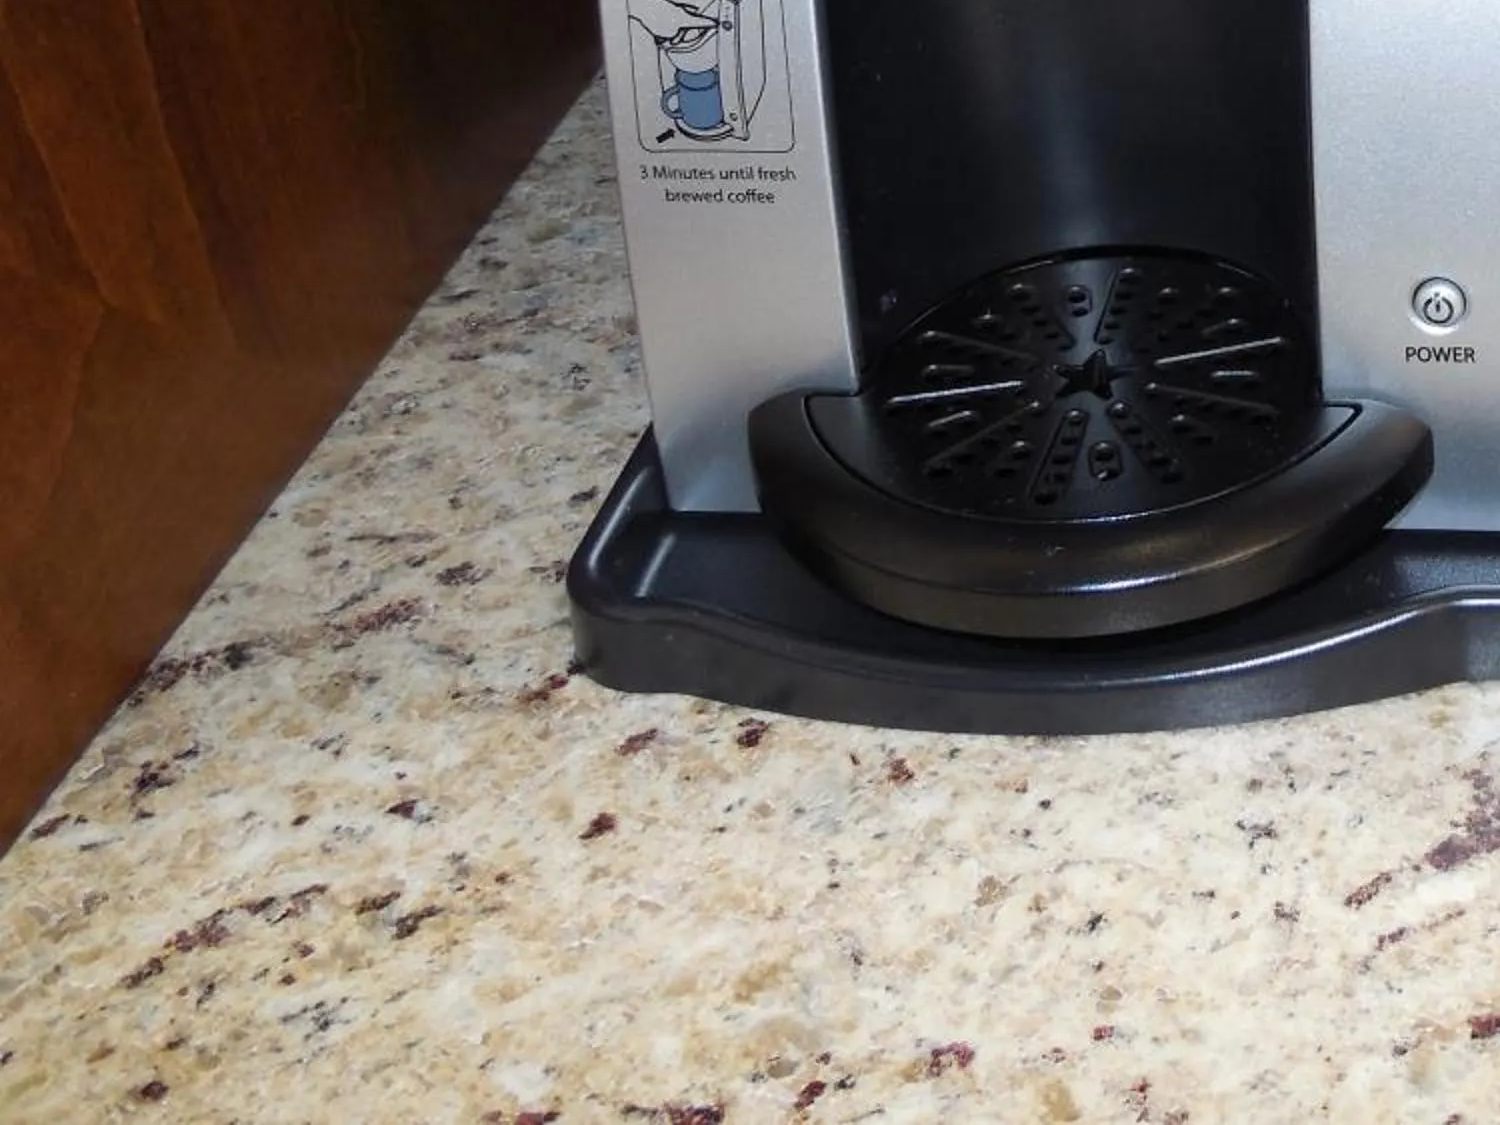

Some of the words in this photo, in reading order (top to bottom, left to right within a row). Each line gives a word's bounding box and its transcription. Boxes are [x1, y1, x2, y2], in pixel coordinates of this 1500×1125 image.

[639, 164, 649, 179] 3
[652, 165, 715, 180] Minutes
[719, 166, 754, 180] until
[757, 166, 797, 182] fresh
[665, 188, 724, 203] brewed
[727, 188, 775, 204] coffee
[1405, 346, 1476, 363] POWER
